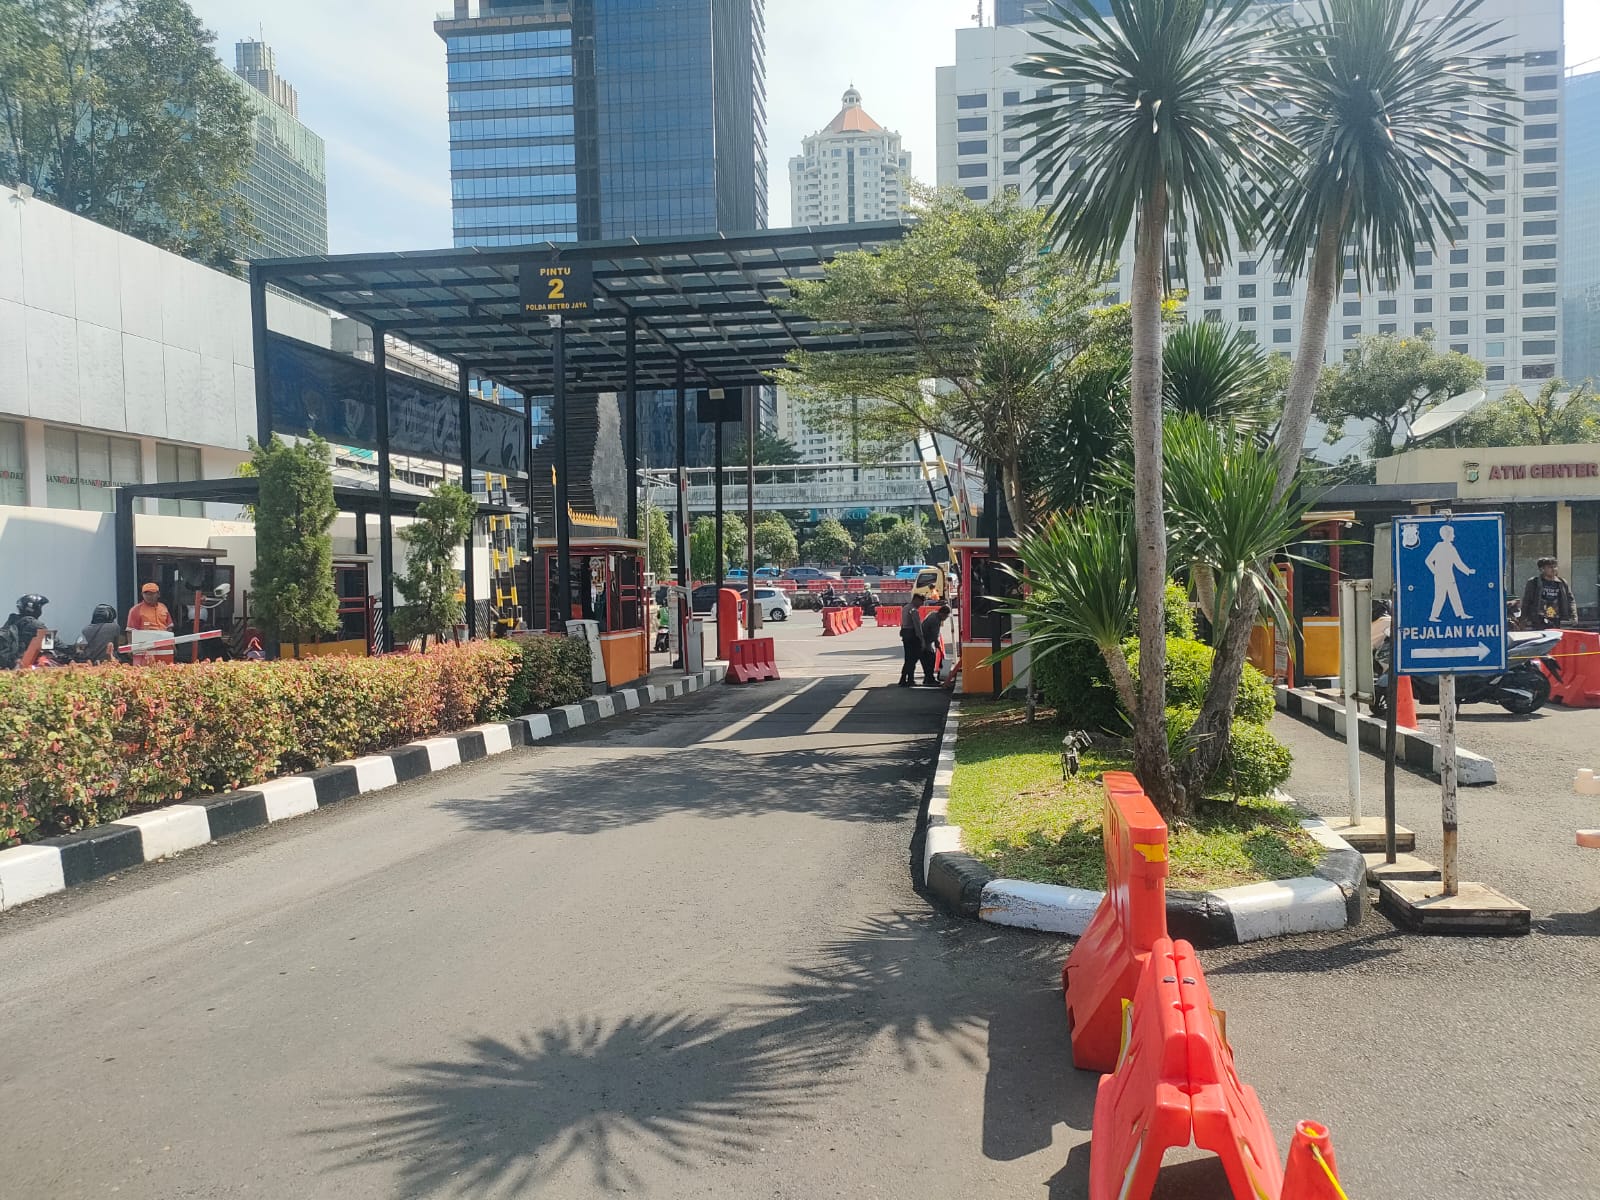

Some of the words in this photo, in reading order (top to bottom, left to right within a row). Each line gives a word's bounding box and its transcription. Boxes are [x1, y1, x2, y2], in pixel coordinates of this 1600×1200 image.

[540, 267, 571, 276] PINTU
[548, 278, 565, 299] 2
[1489, 465, 1526, 480] ATM
[1530, 463, 1599, 479] CENTER
[1402, 625, 1463, 640] PEJALAN
[1466, 624, 1500, 638] KAKI
